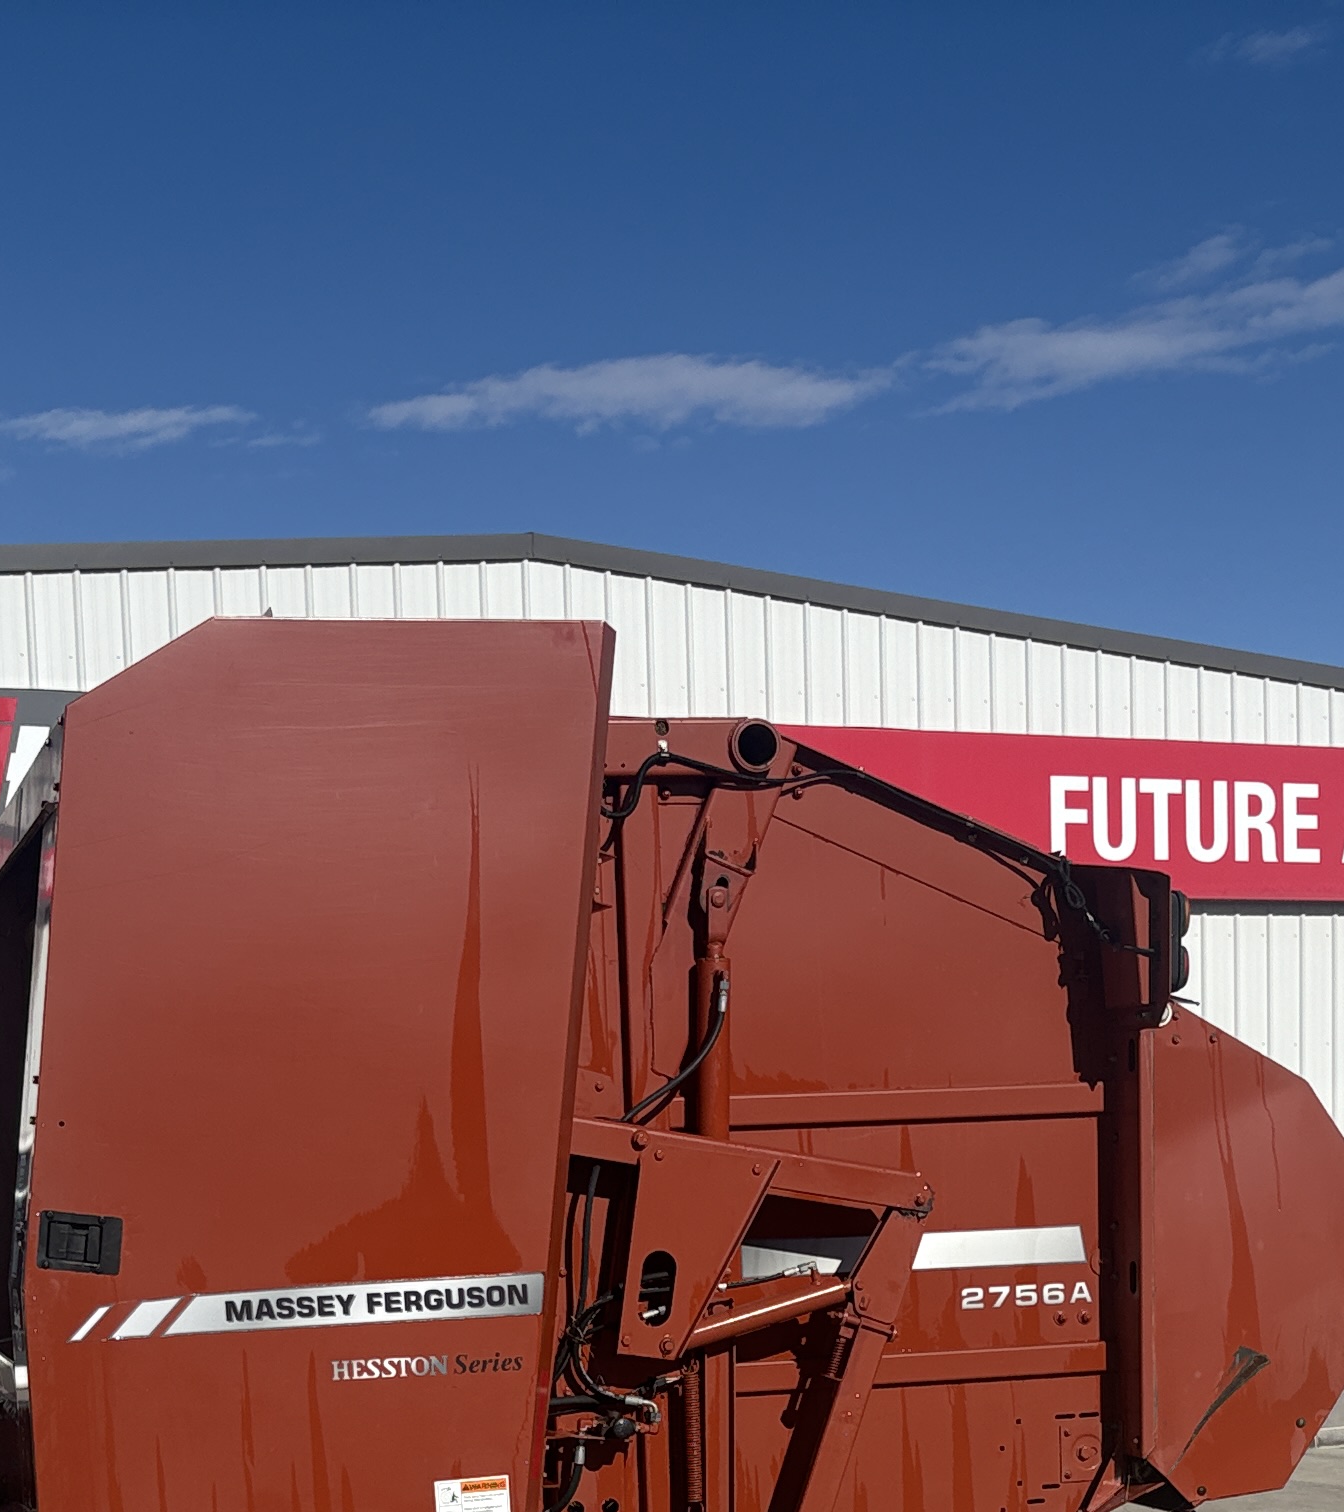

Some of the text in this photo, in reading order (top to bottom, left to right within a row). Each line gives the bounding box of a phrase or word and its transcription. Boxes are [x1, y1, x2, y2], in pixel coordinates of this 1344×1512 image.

[1049, 775, 1322, 863] FUTURE
[225, 1283, 529, 1322] MASSEY FERGUSON
[961, 1281, 1093, 1310] 2756A
[330, 1352, 523, 1381] HESSTON Series
